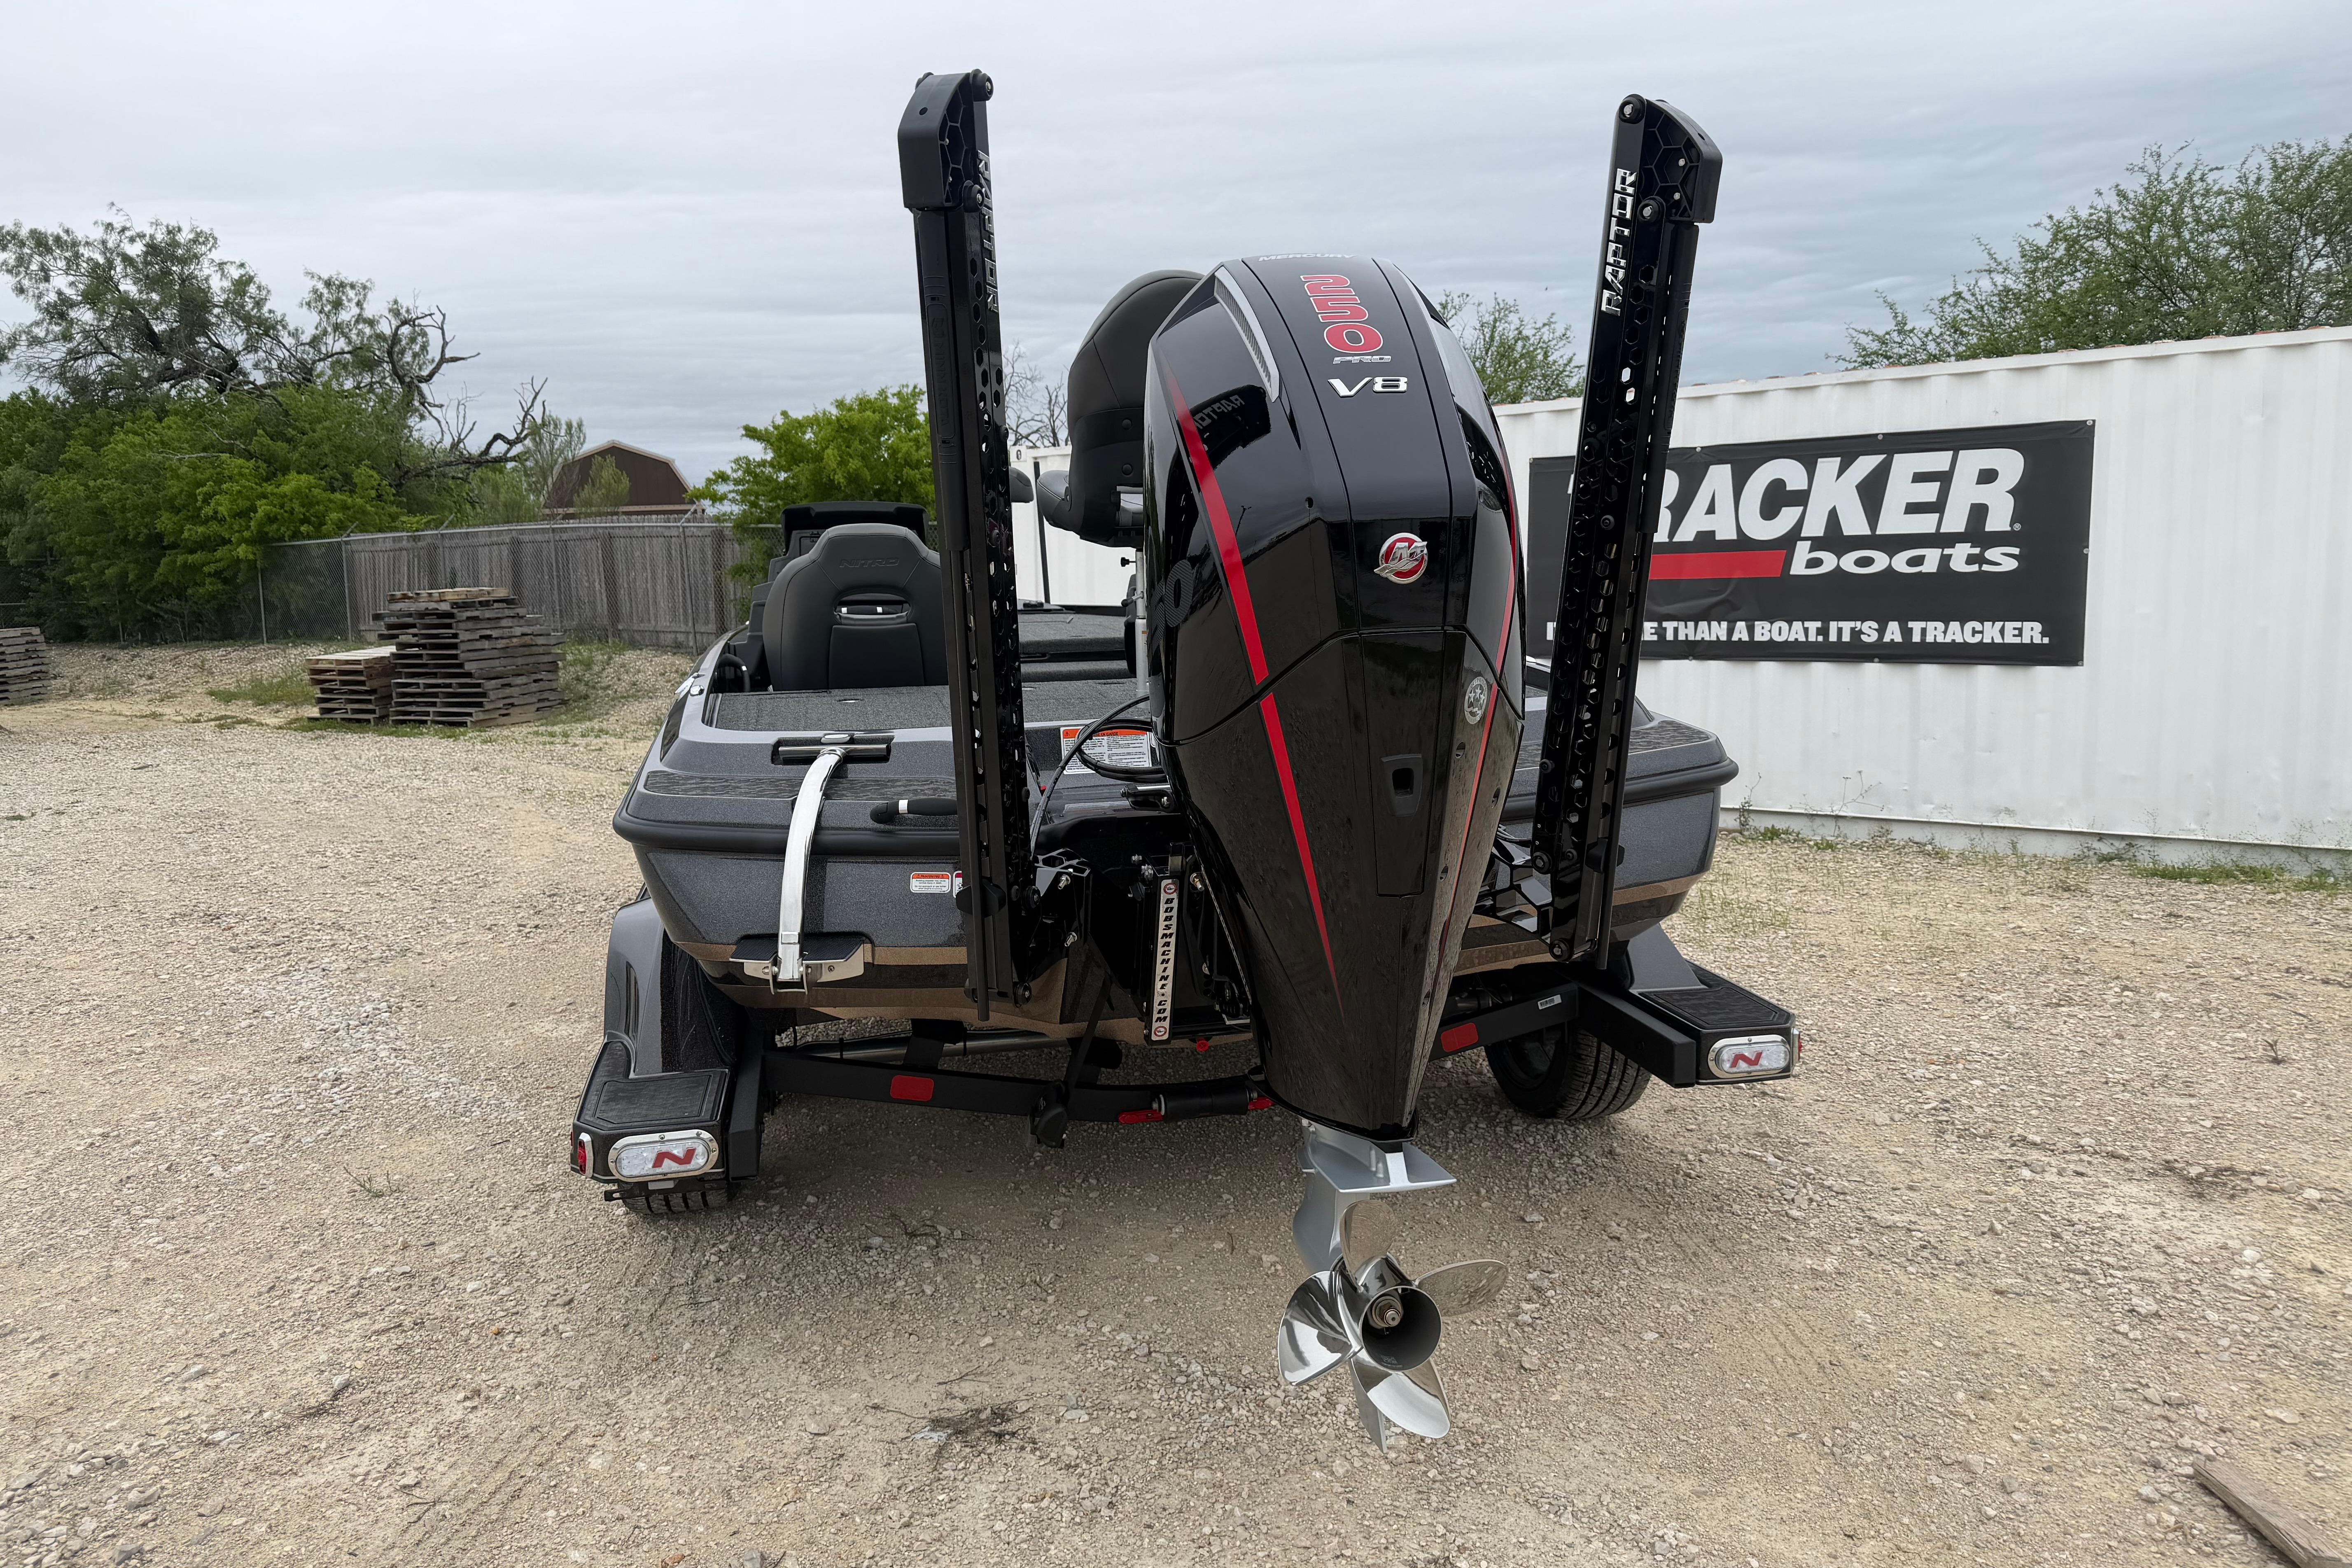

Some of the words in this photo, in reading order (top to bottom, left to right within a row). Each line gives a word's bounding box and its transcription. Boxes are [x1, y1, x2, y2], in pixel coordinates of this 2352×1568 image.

[1601, 168, 1638, 317] RAPTOR
[1258, 253, 1358, 262] MERCURY
[1300, 274, 1383, 353] 250
[1333, 355, 1391, 364] PRO
[1328, 376, 1408, 398] V8
[1568, 448, 2025, 542] ACKER
[839, 558, 900, 567] NITRO
[1790, 540, 2020, 575] boats
[1662, 621, 1727, 641] THAN
[1731, 621, 1749, 641] A
[1754, 621, 1823, 642] BOAT.
[1829, 621, 1878, 642] IT'S
[1883, 621, 1903, 642] A
[1908, 621, 2049, 644] TRACKER.
